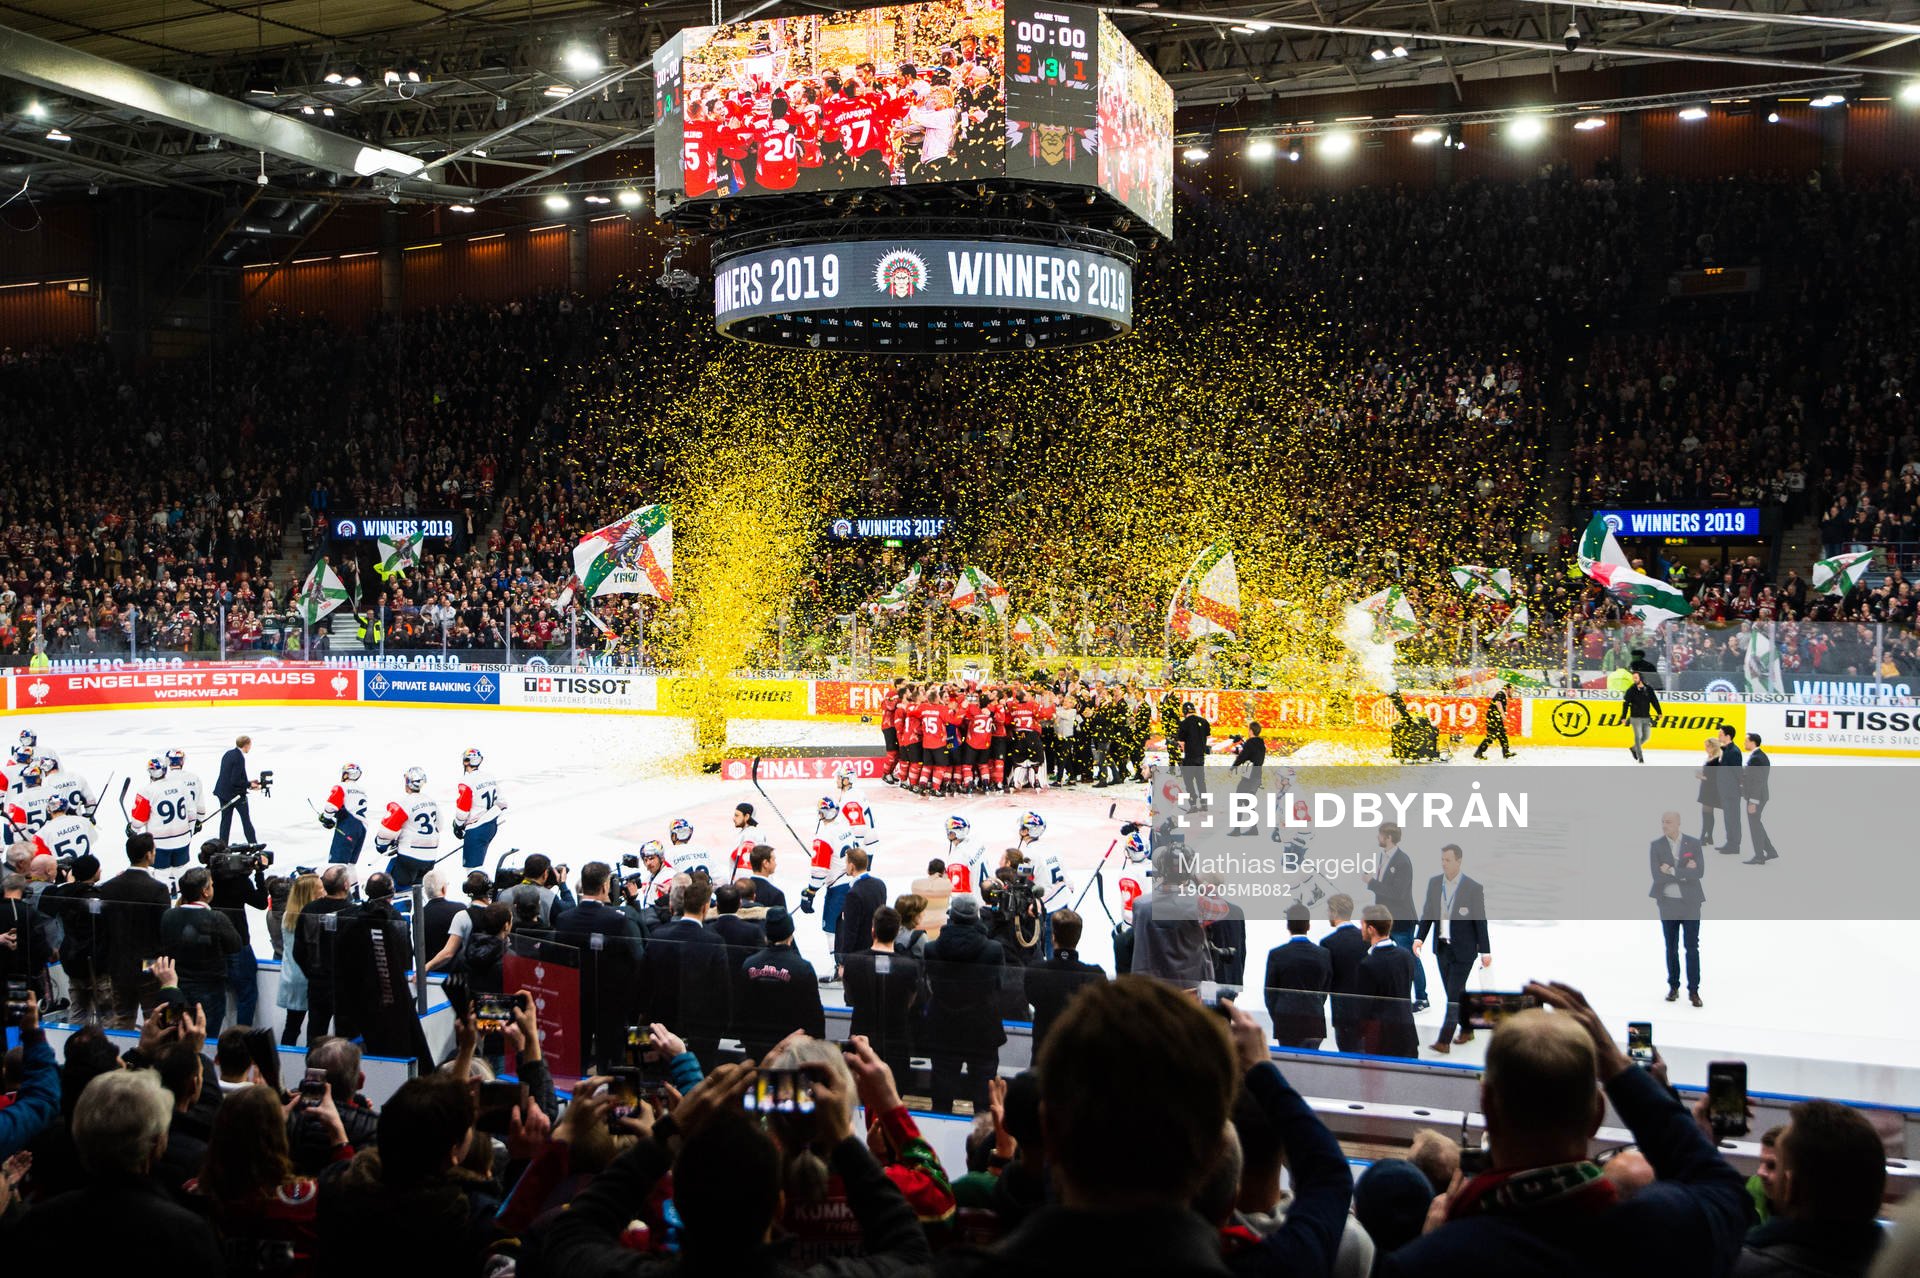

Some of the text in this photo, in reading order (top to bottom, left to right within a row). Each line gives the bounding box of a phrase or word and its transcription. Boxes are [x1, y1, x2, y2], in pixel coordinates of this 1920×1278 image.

[1034, 12, 1070, 23] GAME TIME
[1018, 21, 1086, 48] 00:00
[1016, 44, 1032, 53] FHC
[1017, 54, 1087, 81] 3 3 1
[666, 95, 671, 112] 3
[840, 119, 871, 151] 37
[764, 133, 796, 162] 20
[771, 253, 840, 303] 2019
[948, 251, 1125, 313] WINNERS 2019
[363, 520, 453, 536] WINNERS 2019
[858, 519, 911, 536] WINNERS
[1631, 512, 1745, 532] WINNERS 2019
[480, 664, 513, 673] TISSOT
[68, 672, 316, 690] ENGELBERT STRAUSS
[371, 681, 493, 693] LGT PRIVATE BANKING LGT
[554, 677, 632, 695] TISSOT
[154, 688, 239, 699] WORKWEAR
[524, 696, 549, 704] SWISS
[551, 696, 586, 705] WATCHES
[589, 697, 613, 705] SINCE
[1740, 693, 1794, 703] TISSOT
[1279, 697, 1368, 726] FINL
[922, 717, 938, 734] 15
[973, 717, 993, 734] 20
[1784, 732, 1822, 742] SWISS
[1827, 734, 1885, 744] WATCHES
[756, 760, 811, 779] FINAL
[831, 759, 874, 777] 2019
[157, 796, 187, 825] 96
[57, 824, 81, 837] HAGER
[54, 833, 91, 858] 52
